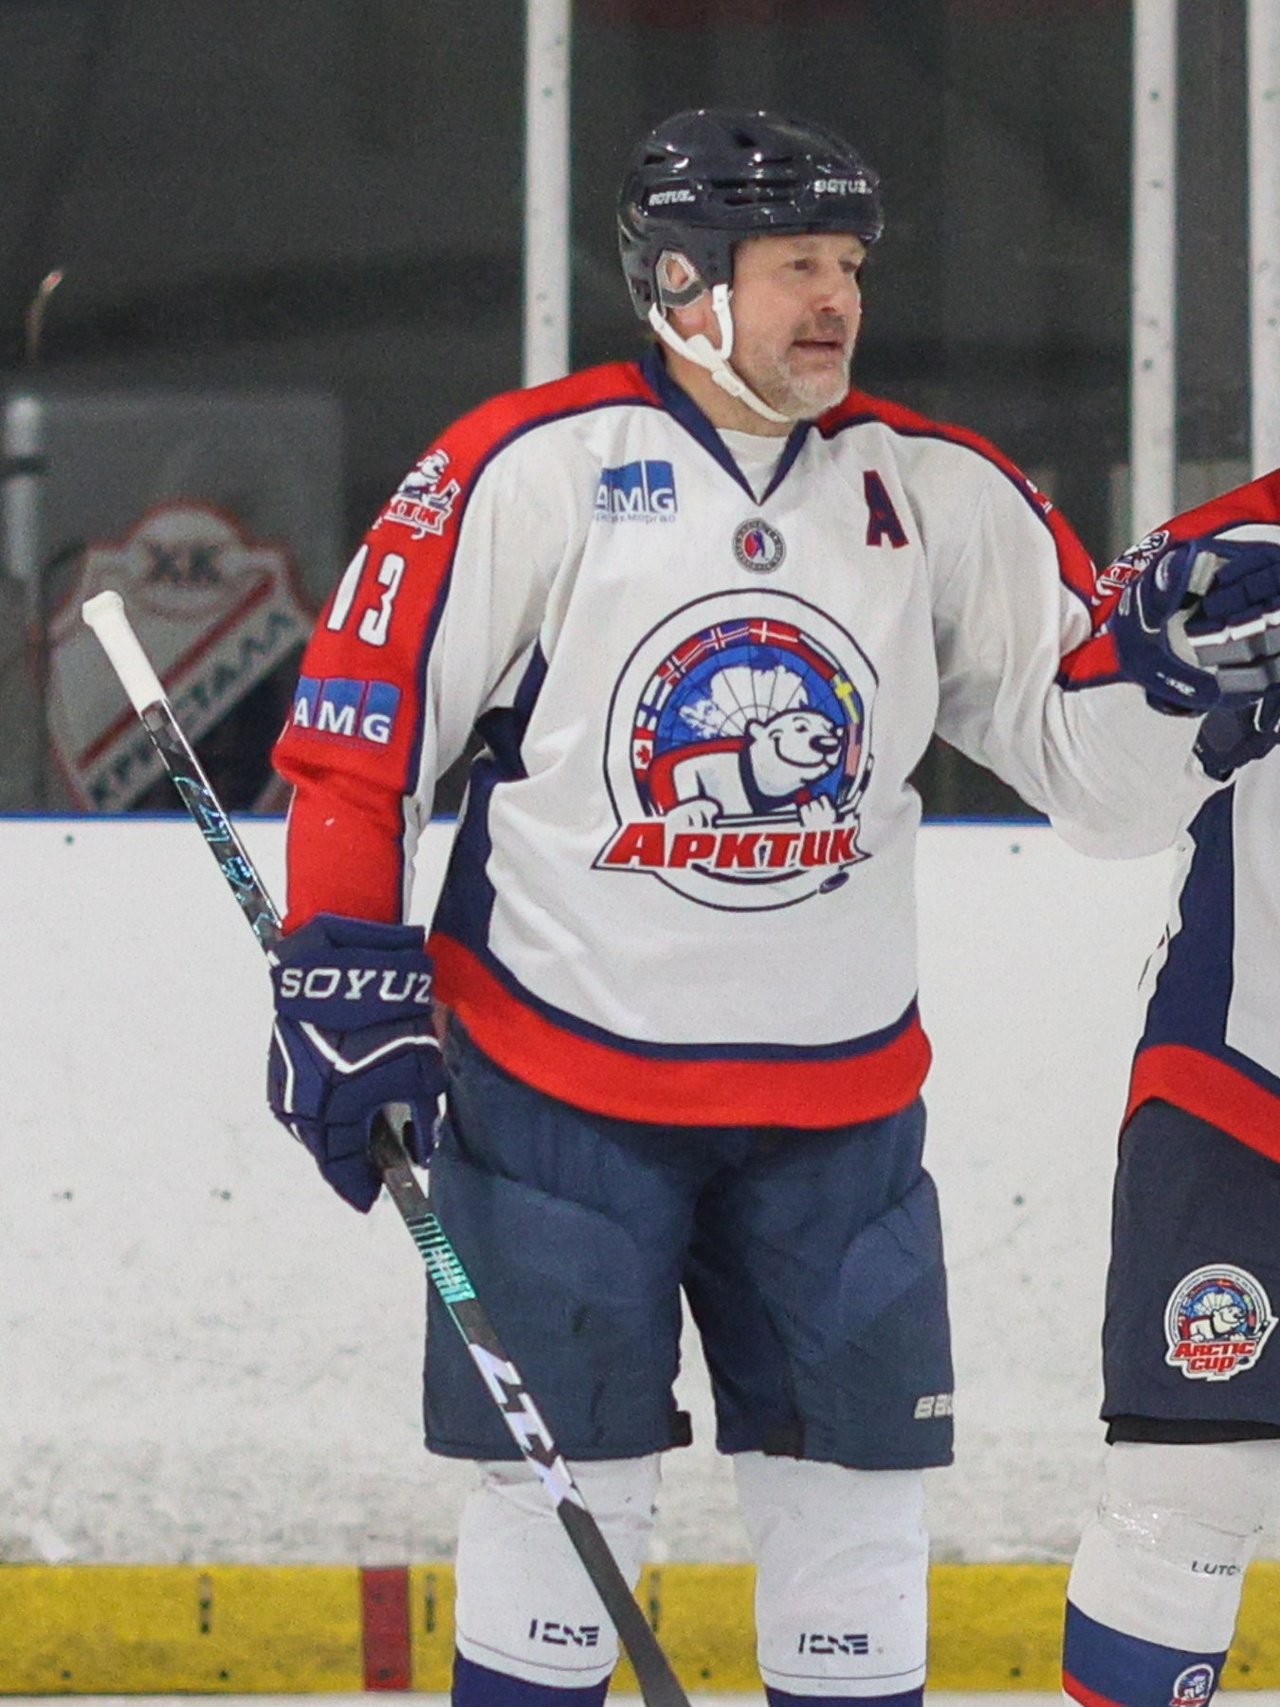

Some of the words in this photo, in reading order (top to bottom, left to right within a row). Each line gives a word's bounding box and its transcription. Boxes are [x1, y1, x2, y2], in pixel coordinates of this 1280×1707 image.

[594, 484, 674, 513] AMG
[864, 470, 910, 548] A
[327, 544, 405, 646] 13
[293, 696, 391, 744] AMG
[280, 967, 432, 1003] SOYUZ
[1174, 1342, 1256, 1358] ARCTIC
[1189, 1357, 1236, 1373] CUP
